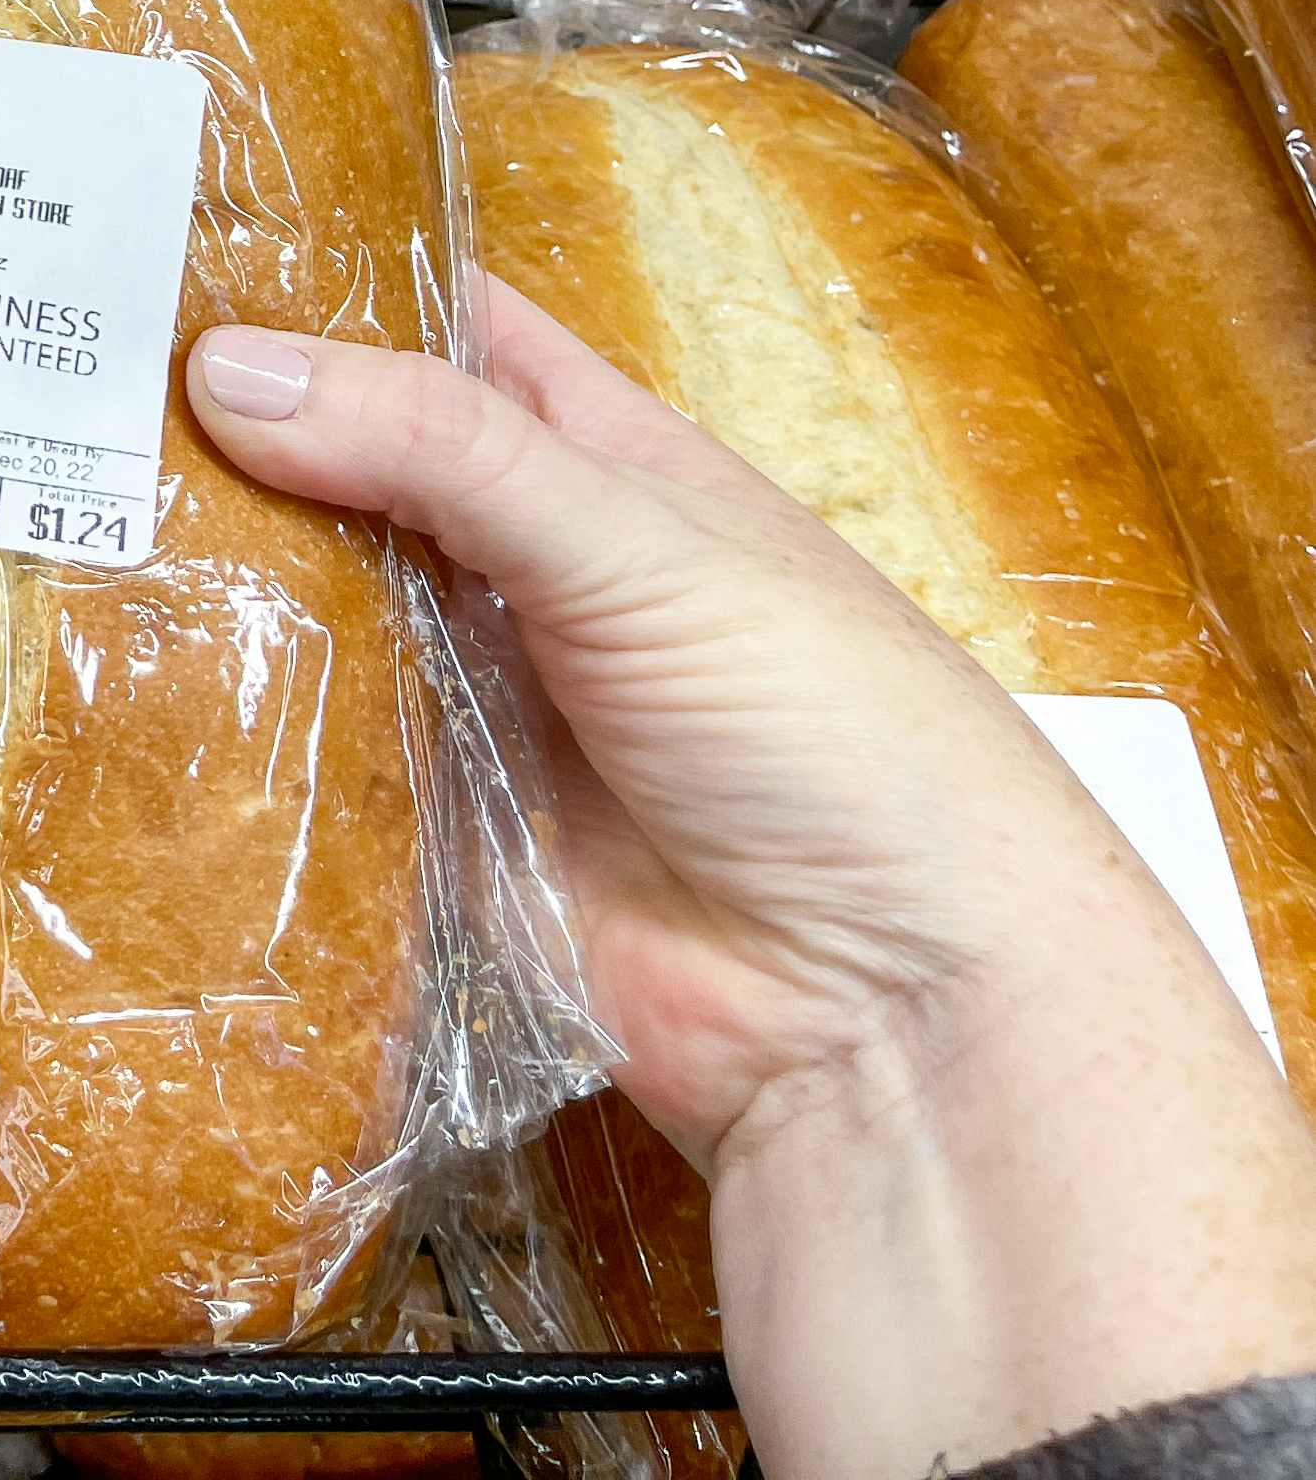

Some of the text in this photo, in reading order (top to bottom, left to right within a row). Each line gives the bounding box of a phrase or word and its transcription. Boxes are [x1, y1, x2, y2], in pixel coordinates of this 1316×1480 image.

[12, 197, 74, 227] STORE
[43, 439, 78, 458] Used
[84, 446, 105, 463] By
[66, 463, 94, 483] 22
[38, 487, 118, 509] Total Price
[27, 501, 129, 553] $1.24
